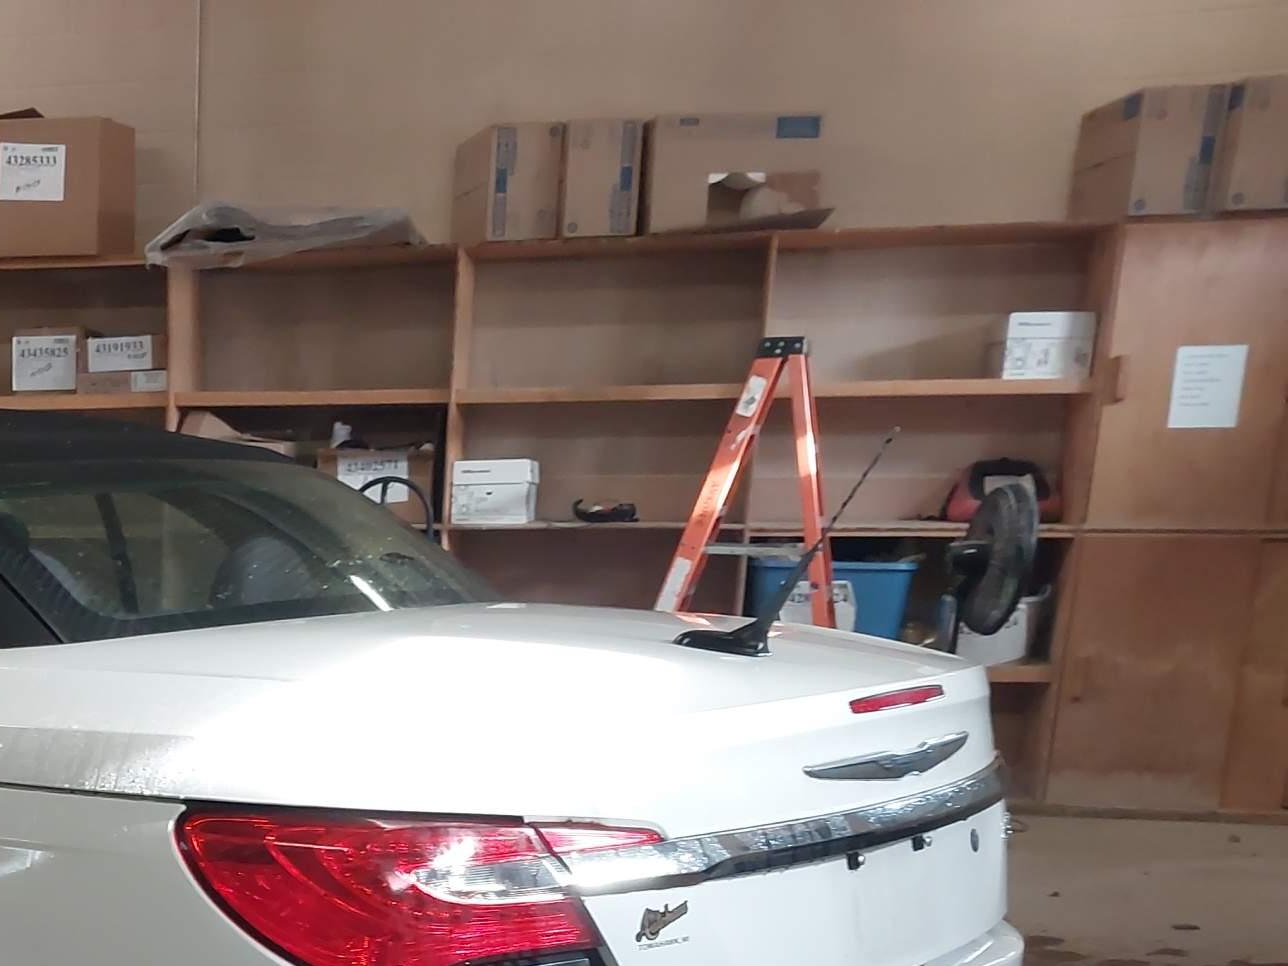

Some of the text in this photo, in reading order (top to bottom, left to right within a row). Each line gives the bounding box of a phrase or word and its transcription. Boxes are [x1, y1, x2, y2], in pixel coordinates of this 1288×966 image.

[5, 154, 57, 167] 43285333
[19, 346, 69, 359] 43435825
[94, 340, 145, 353] 43191933
